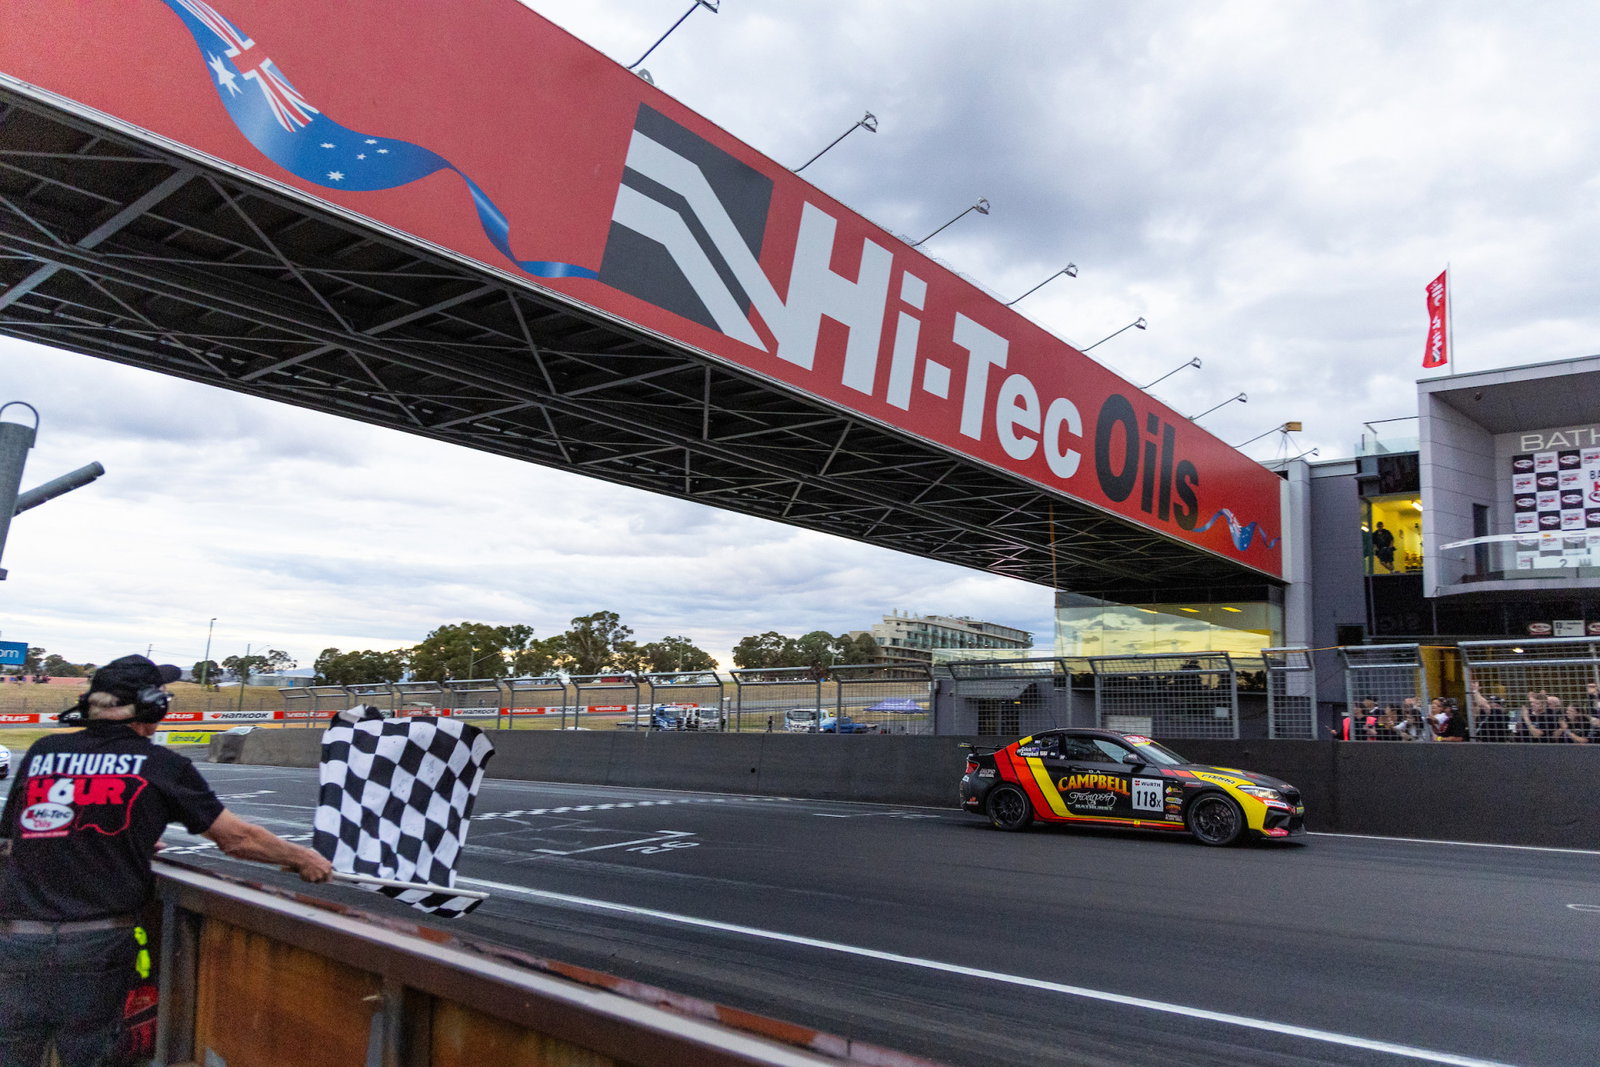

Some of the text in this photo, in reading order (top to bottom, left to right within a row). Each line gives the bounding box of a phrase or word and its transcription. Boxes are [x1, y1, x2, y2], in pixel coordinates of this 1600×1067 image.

[778, 200, 1199, 531] Hi-Tec Oils
[28, 753, 147, 776] BATHURST
[1057, 774, 1130, 796] CAMPBELL
